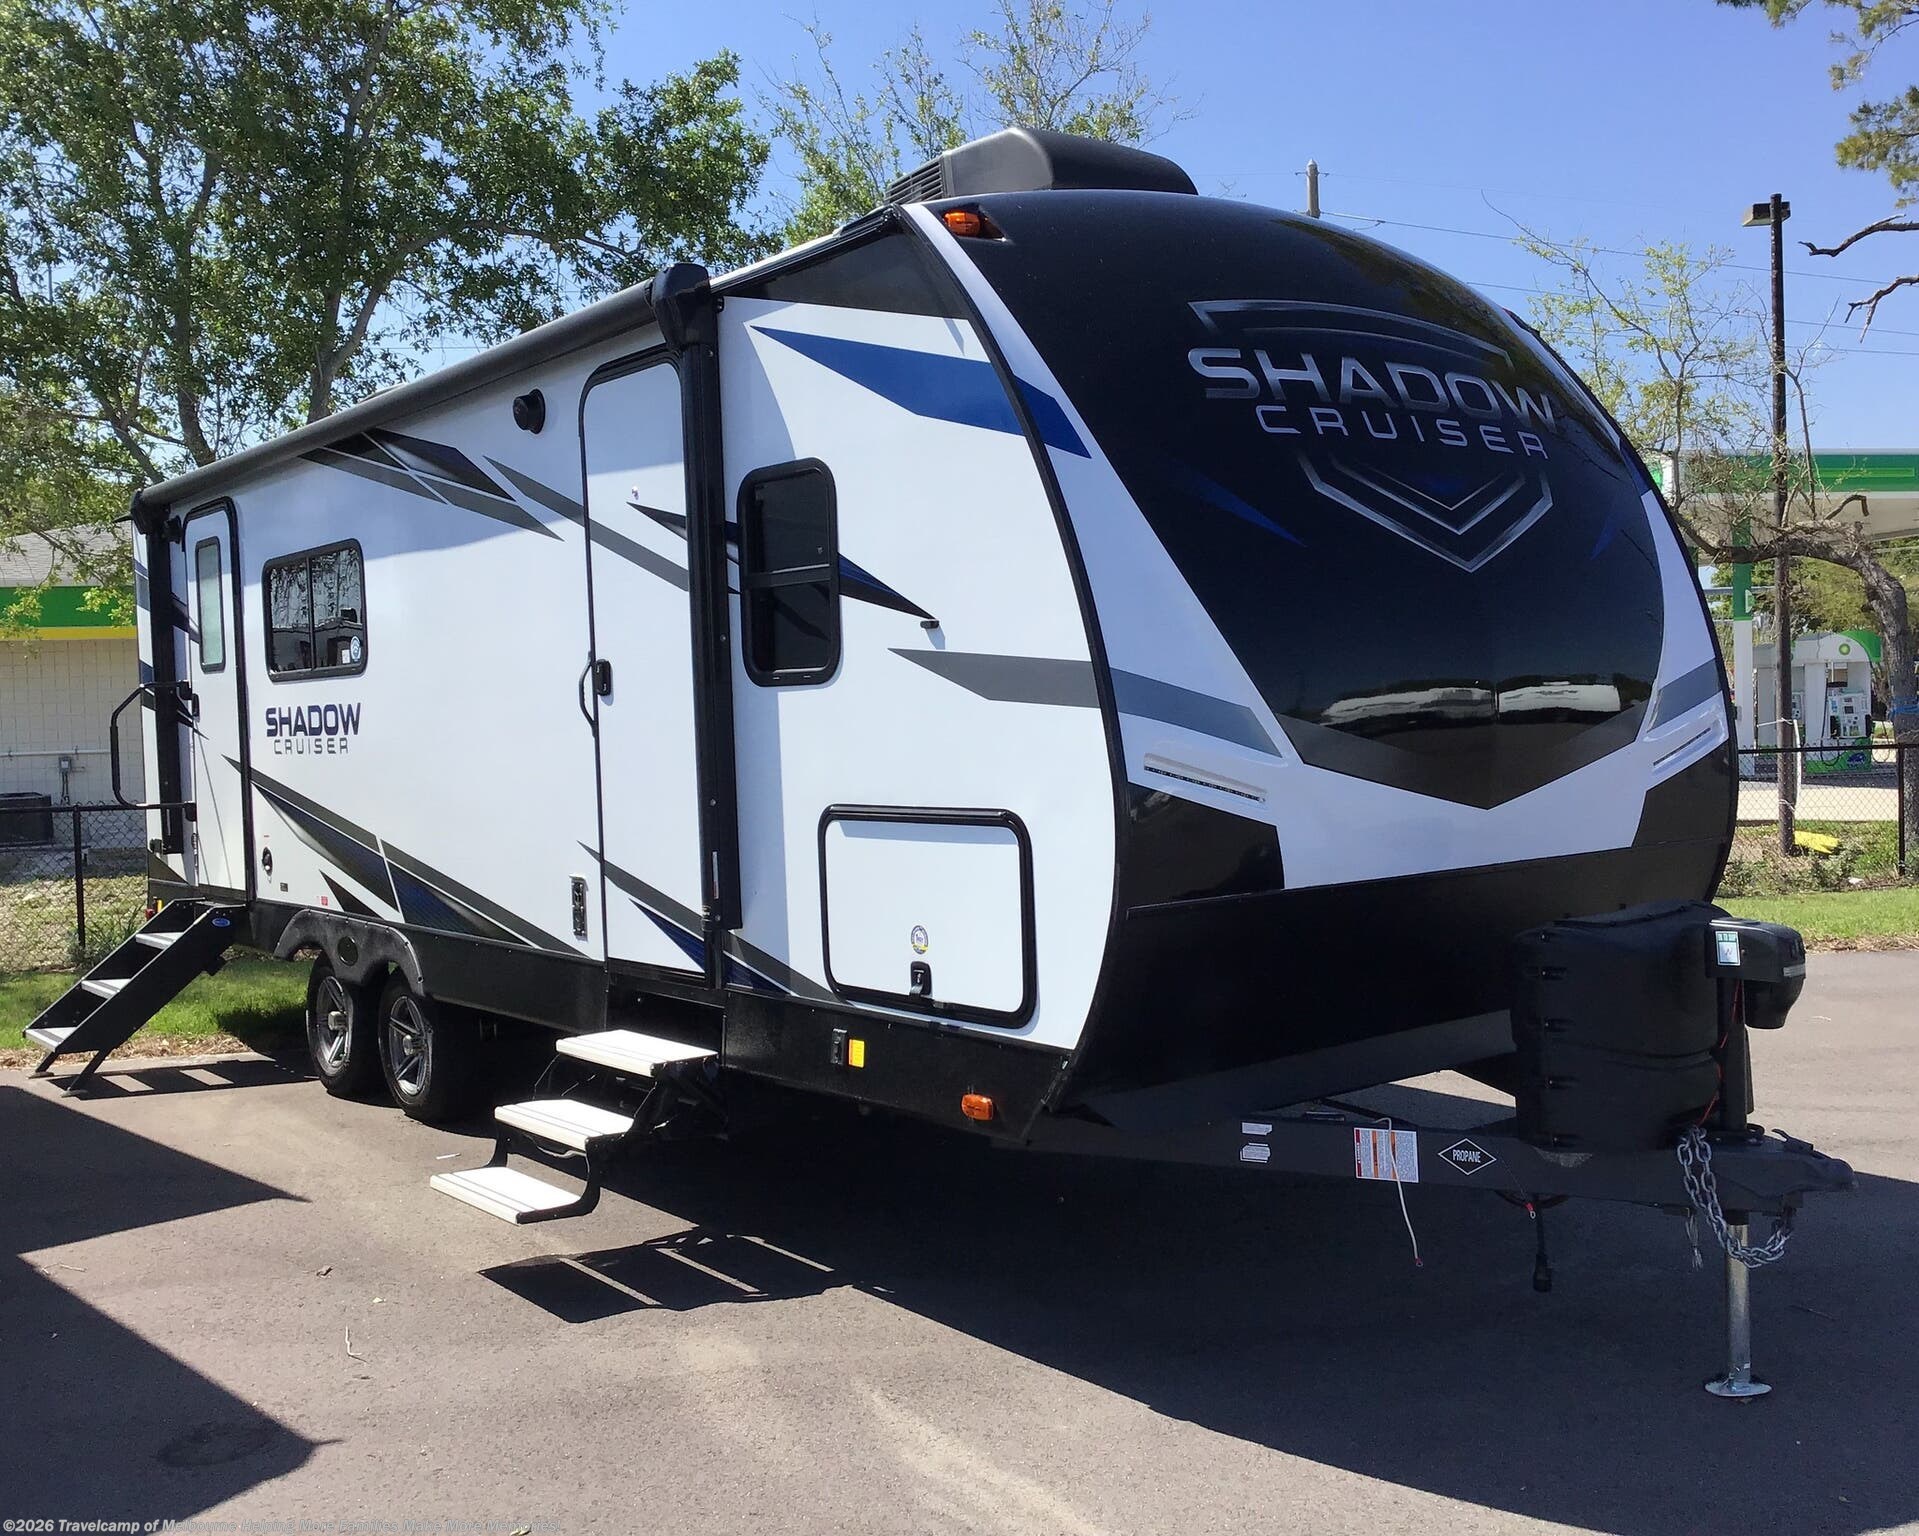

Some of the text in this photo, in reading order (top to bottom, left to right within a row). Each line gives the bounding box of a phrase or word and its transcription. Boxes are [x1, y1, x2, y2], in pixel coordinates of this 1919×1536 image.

[1188, 347, 1557, 433] SHADOW
[1255, 404, 1549, 459] CRUISER
[265, 702, 361, 737] SHADOW
[273, 737, 349, 755] CRUISER
[1452, 1149, 1481, 1163] PROPANE
